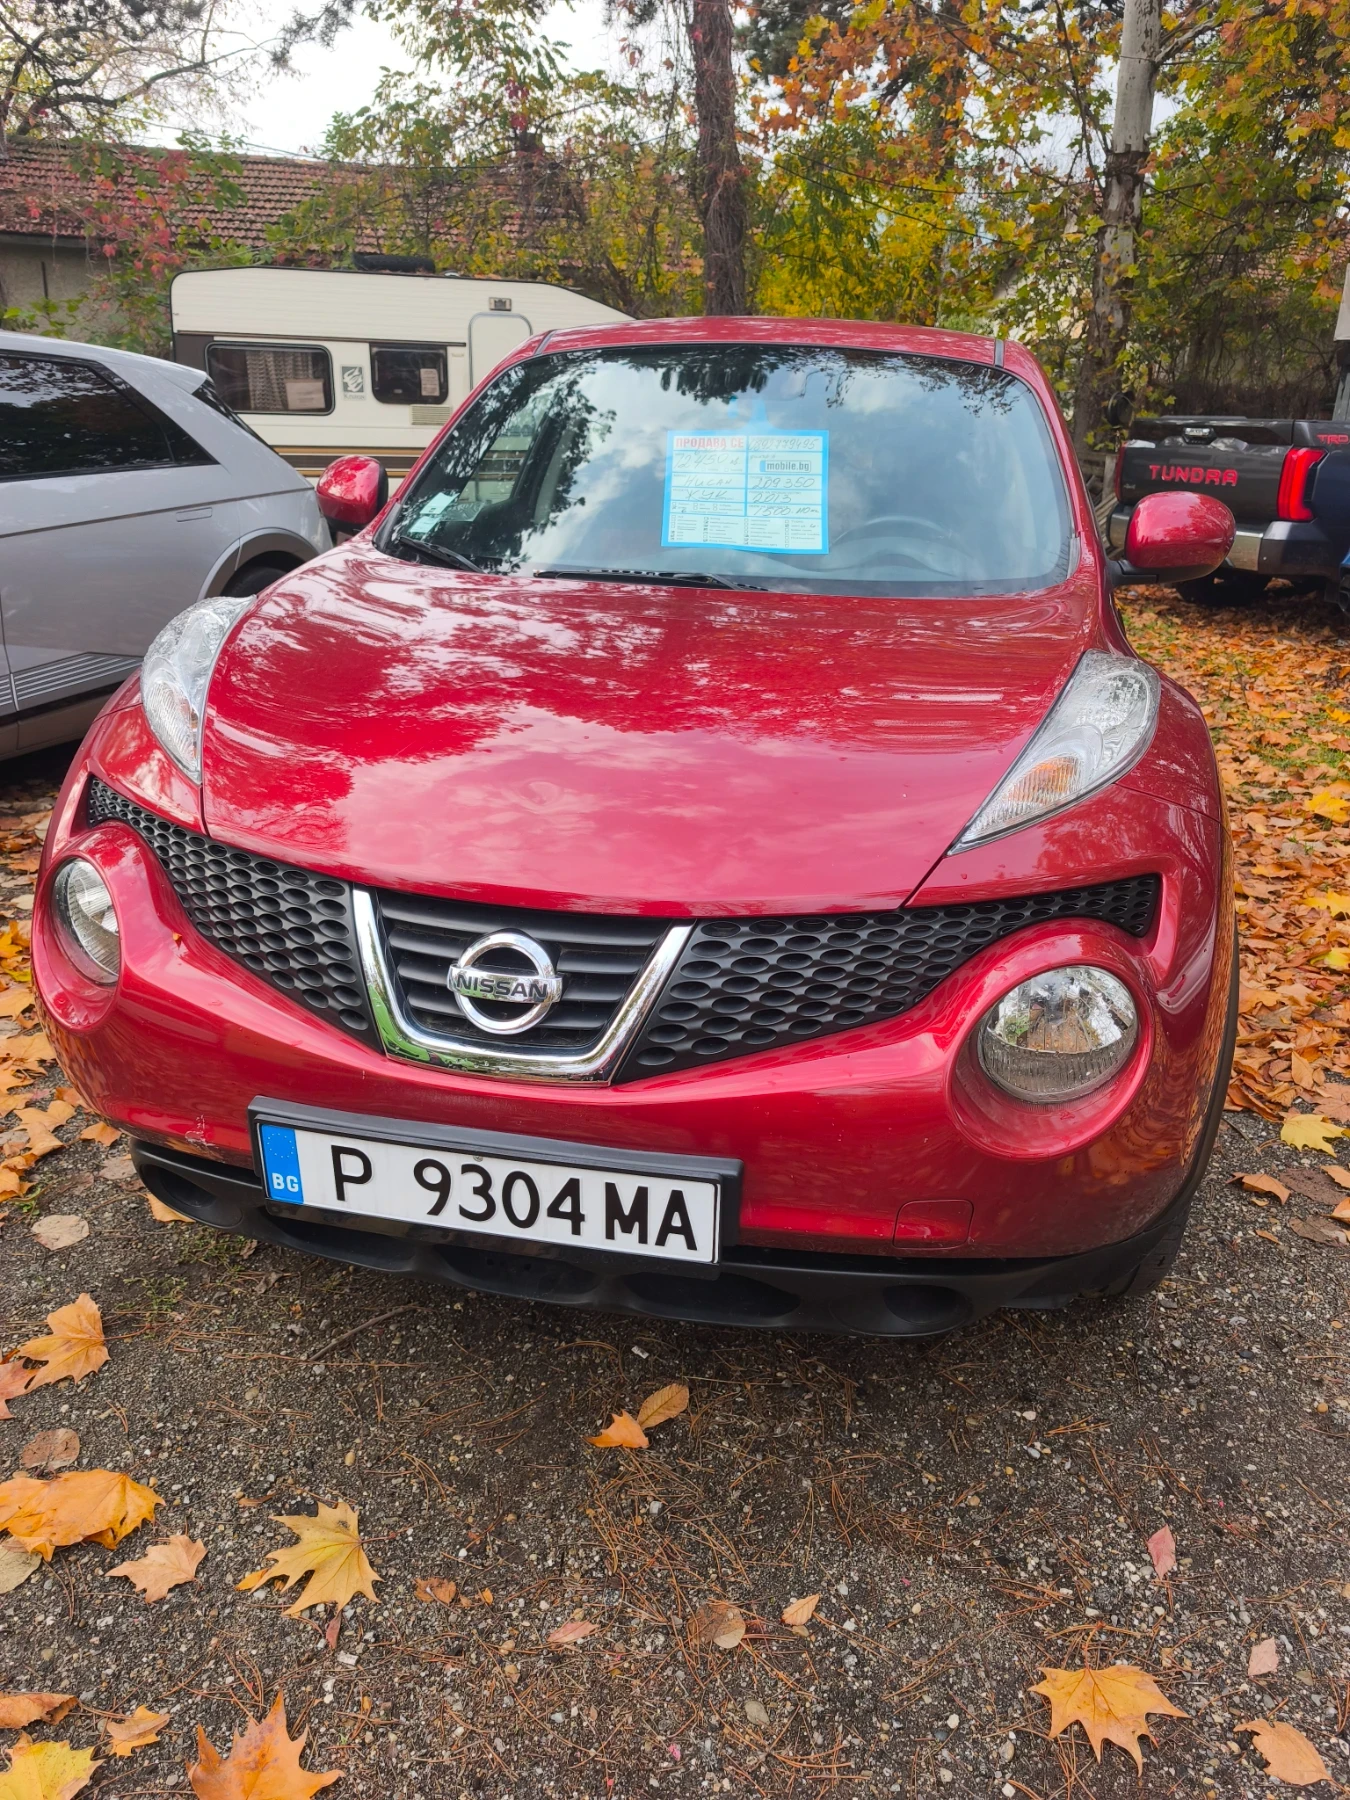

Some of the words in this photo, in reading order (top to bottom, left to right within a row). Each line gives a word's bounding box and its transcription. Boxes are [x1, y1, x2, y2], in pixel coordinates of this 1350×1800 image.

[676, 437, 727, 448] ПРОДАВА
[730, 437, 744, 448] СЕ
[1316, 434, 1349, 445] TRD
[767, 461, 810, 472] mobile.bg
[1148, 464, 1239, 487] TUNDRA
[752, 492, 792, 504] 2013
[456, 974, 548, 999] NISSAN
[271, 1172, 299, 1193] BG
[330, 1144, 374, 1202] P
[413, 1158, 586, 1236] 9304
[604, 1181, 698, 1251] MA
